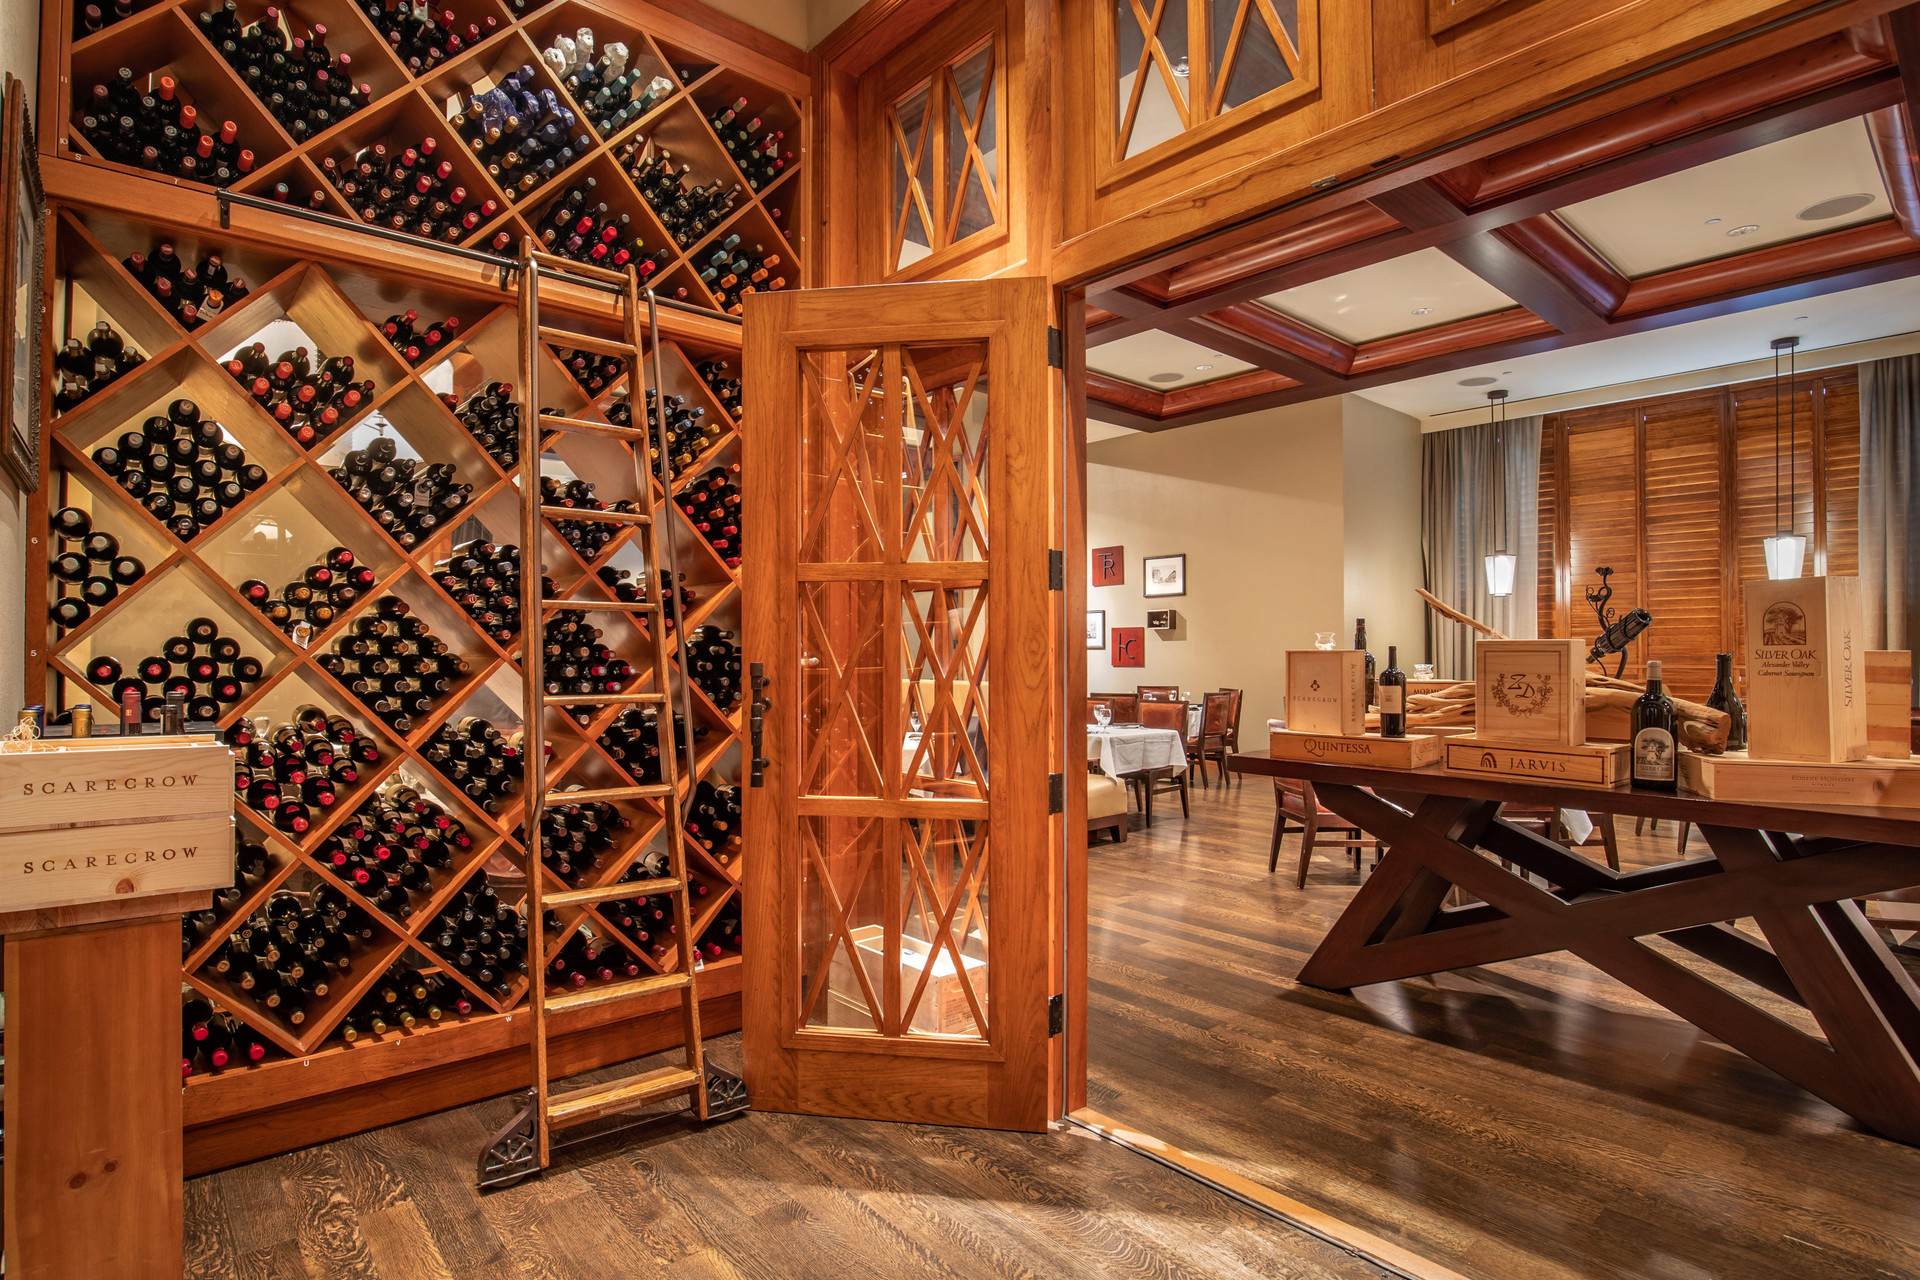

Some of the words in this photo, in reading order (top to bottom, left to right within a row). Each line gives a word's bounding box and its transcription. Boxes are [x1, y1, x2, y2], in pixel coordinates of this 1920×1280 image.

[1754, 649, 1790, 660] SILVER
[1790, 649, 1817, 660] OAK
[1843, 629, 1852, 661] OAK
[1758, 669, 1783, 677] Cabernet
[1784, 669, 1815, 678] Sauvignon
[1792, 661, 1810, 669] Valley
[1844, 662, 1852, 708] SILVER
[1304, 738, 1371, 757] QUINTESSA
[1510, 757, 1565, 772] JARVIS
[23, 774, 198, 796] SCARECROW
[23, 846, 198, 874] SCARECROW
